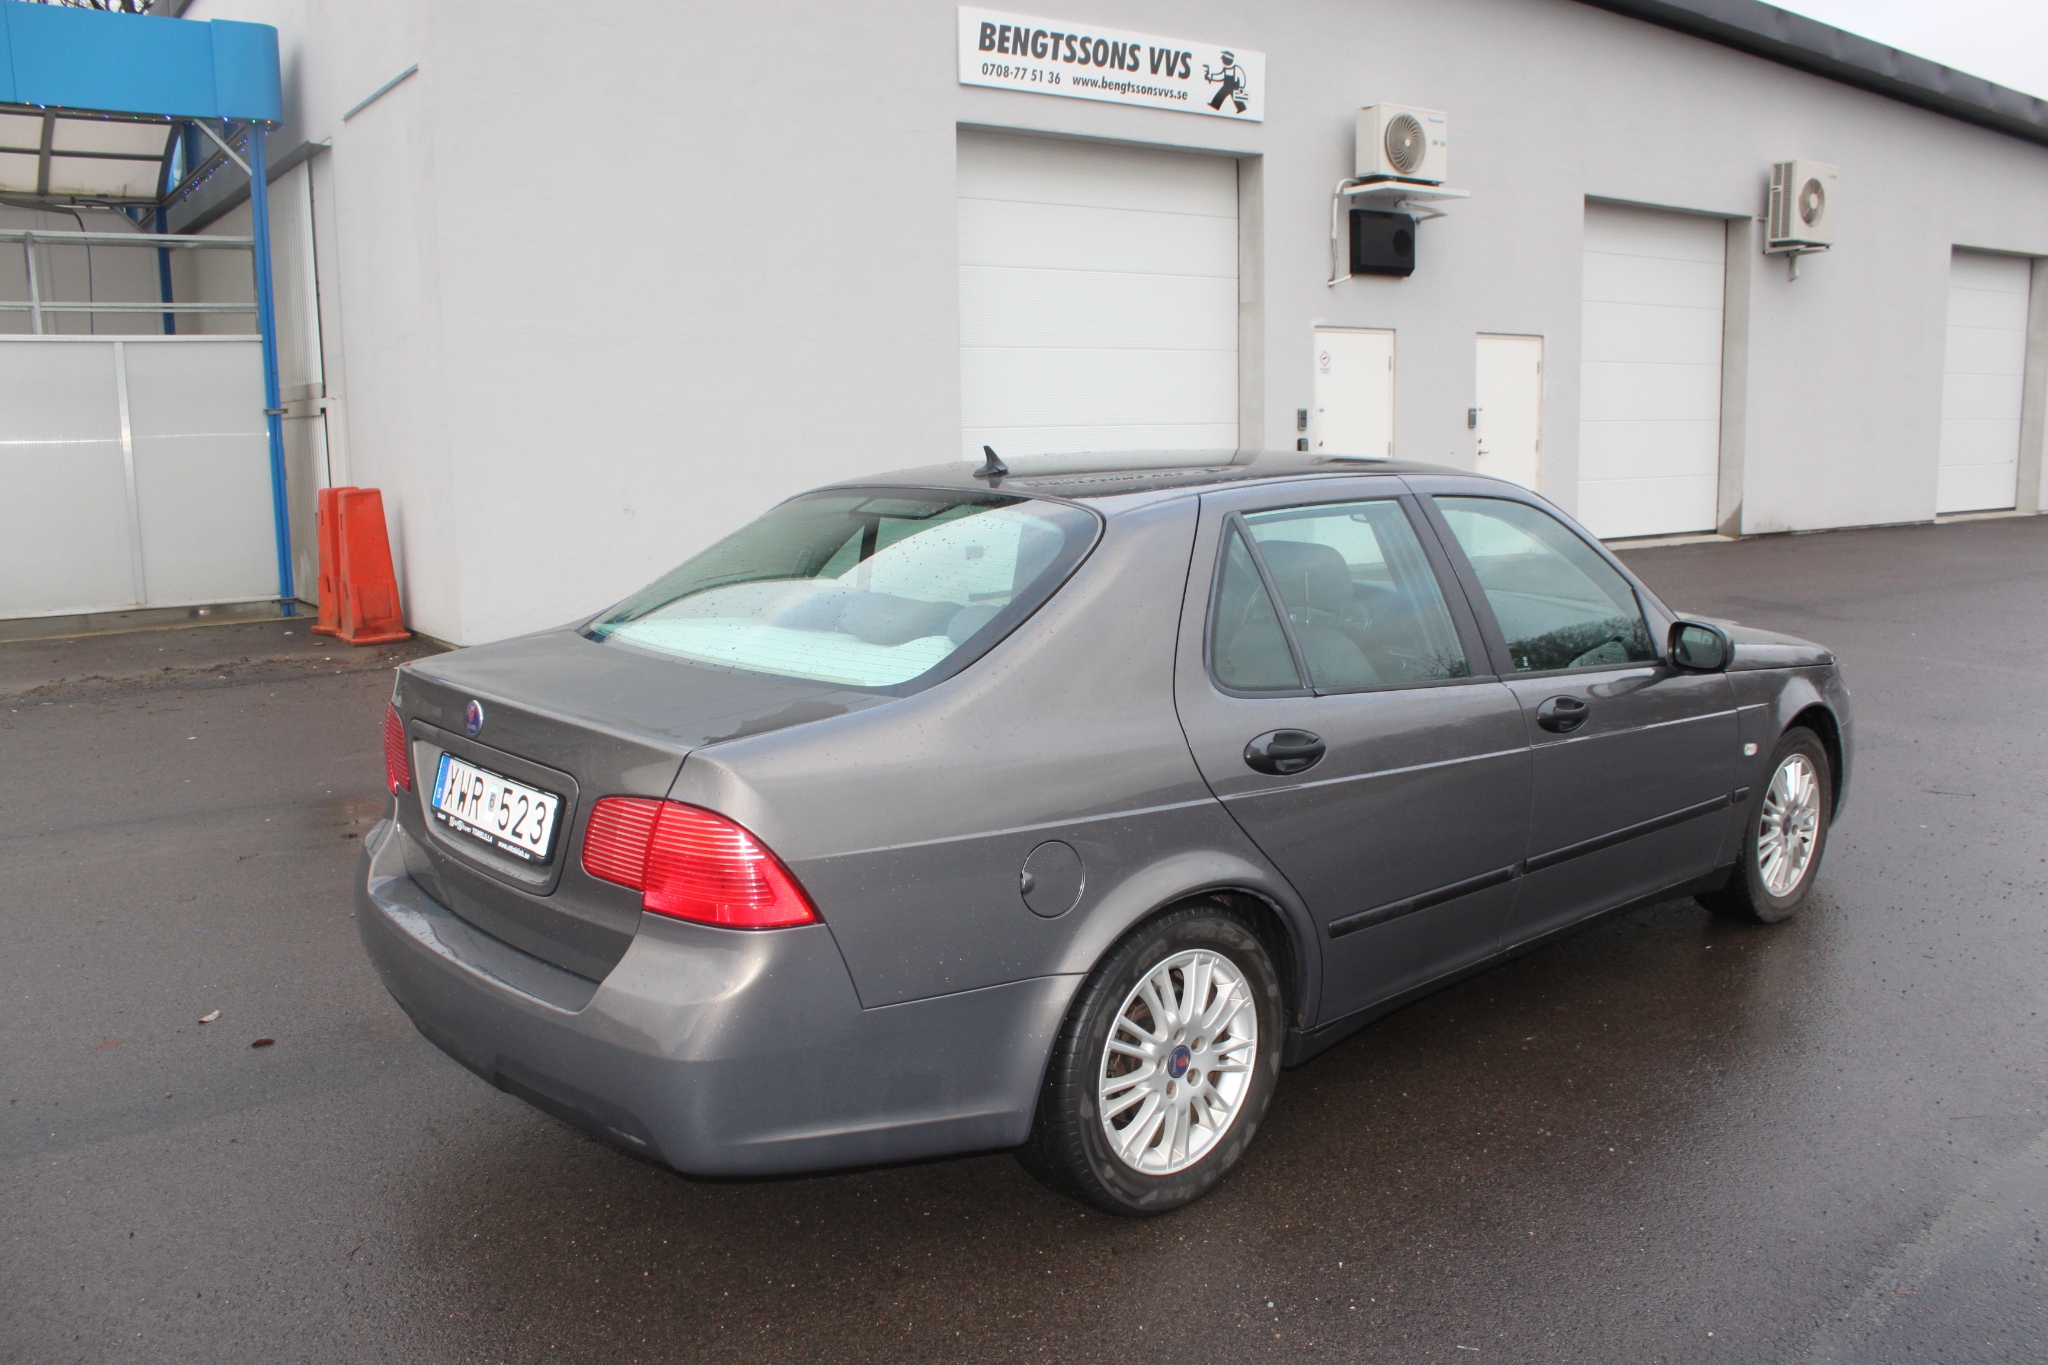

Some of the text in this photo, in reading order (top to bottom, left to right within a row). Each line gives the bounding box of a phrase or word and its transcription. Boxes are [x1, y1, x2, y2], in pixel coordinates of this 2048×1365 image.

[978, 21, 1192, 80] BENGTSSONS VVS
[981, 62, 1188, 101] 0708-77 51 36 www.bengtssonsvvs.se
[444, 764, 485, 820] XWR
[497, 786, 547, 845] 523
